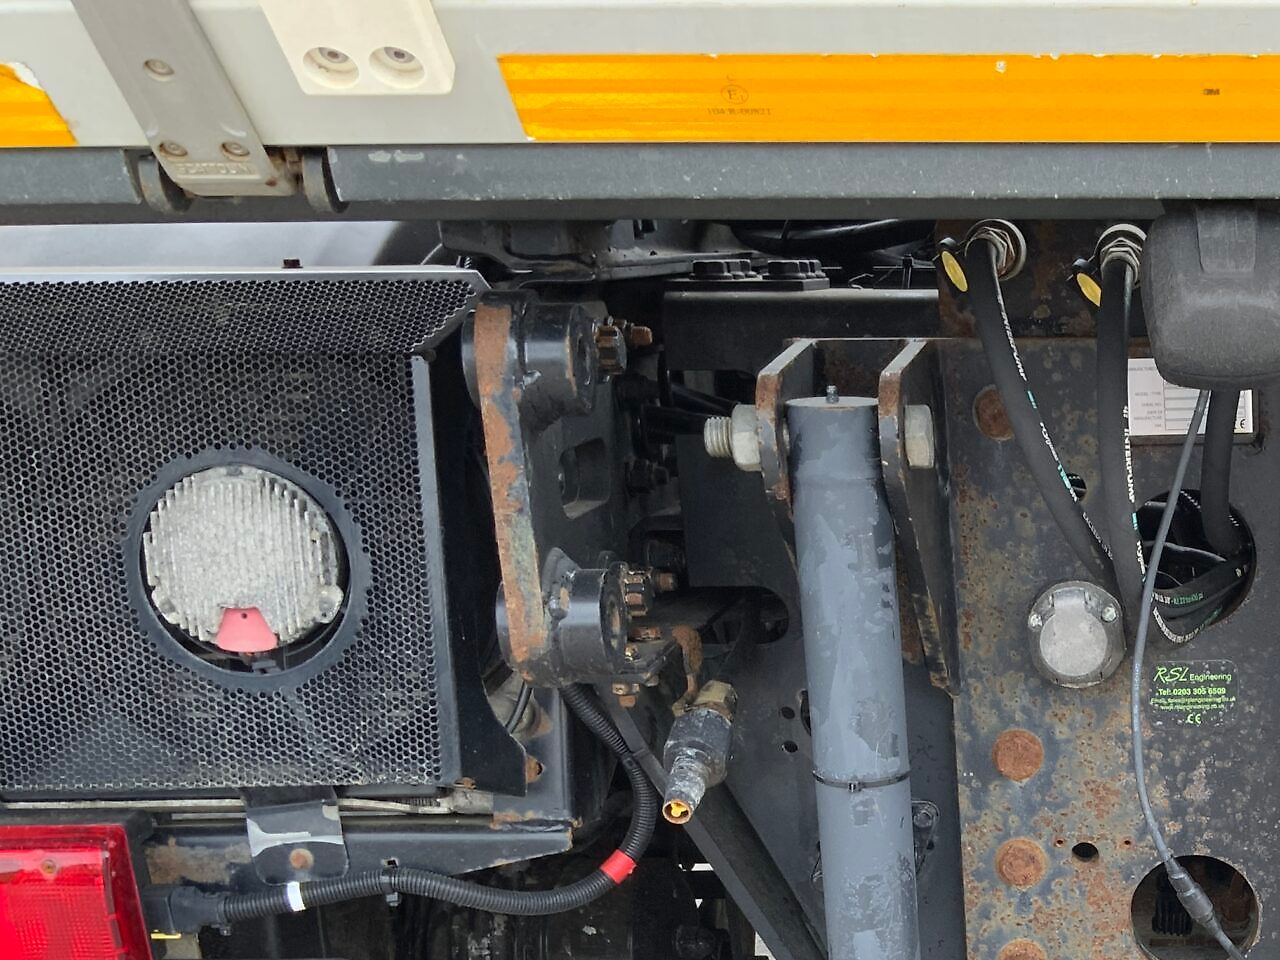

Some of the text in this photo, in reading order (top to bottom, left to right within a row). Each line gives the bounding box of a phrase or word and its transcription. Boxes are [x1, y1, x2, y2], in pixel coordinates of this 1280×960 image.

[1153, 666, 1232, 684] RSL Engineering
[1173, 688, 1191, 696] 0203
[1192, 687, 1207, 695] 305
